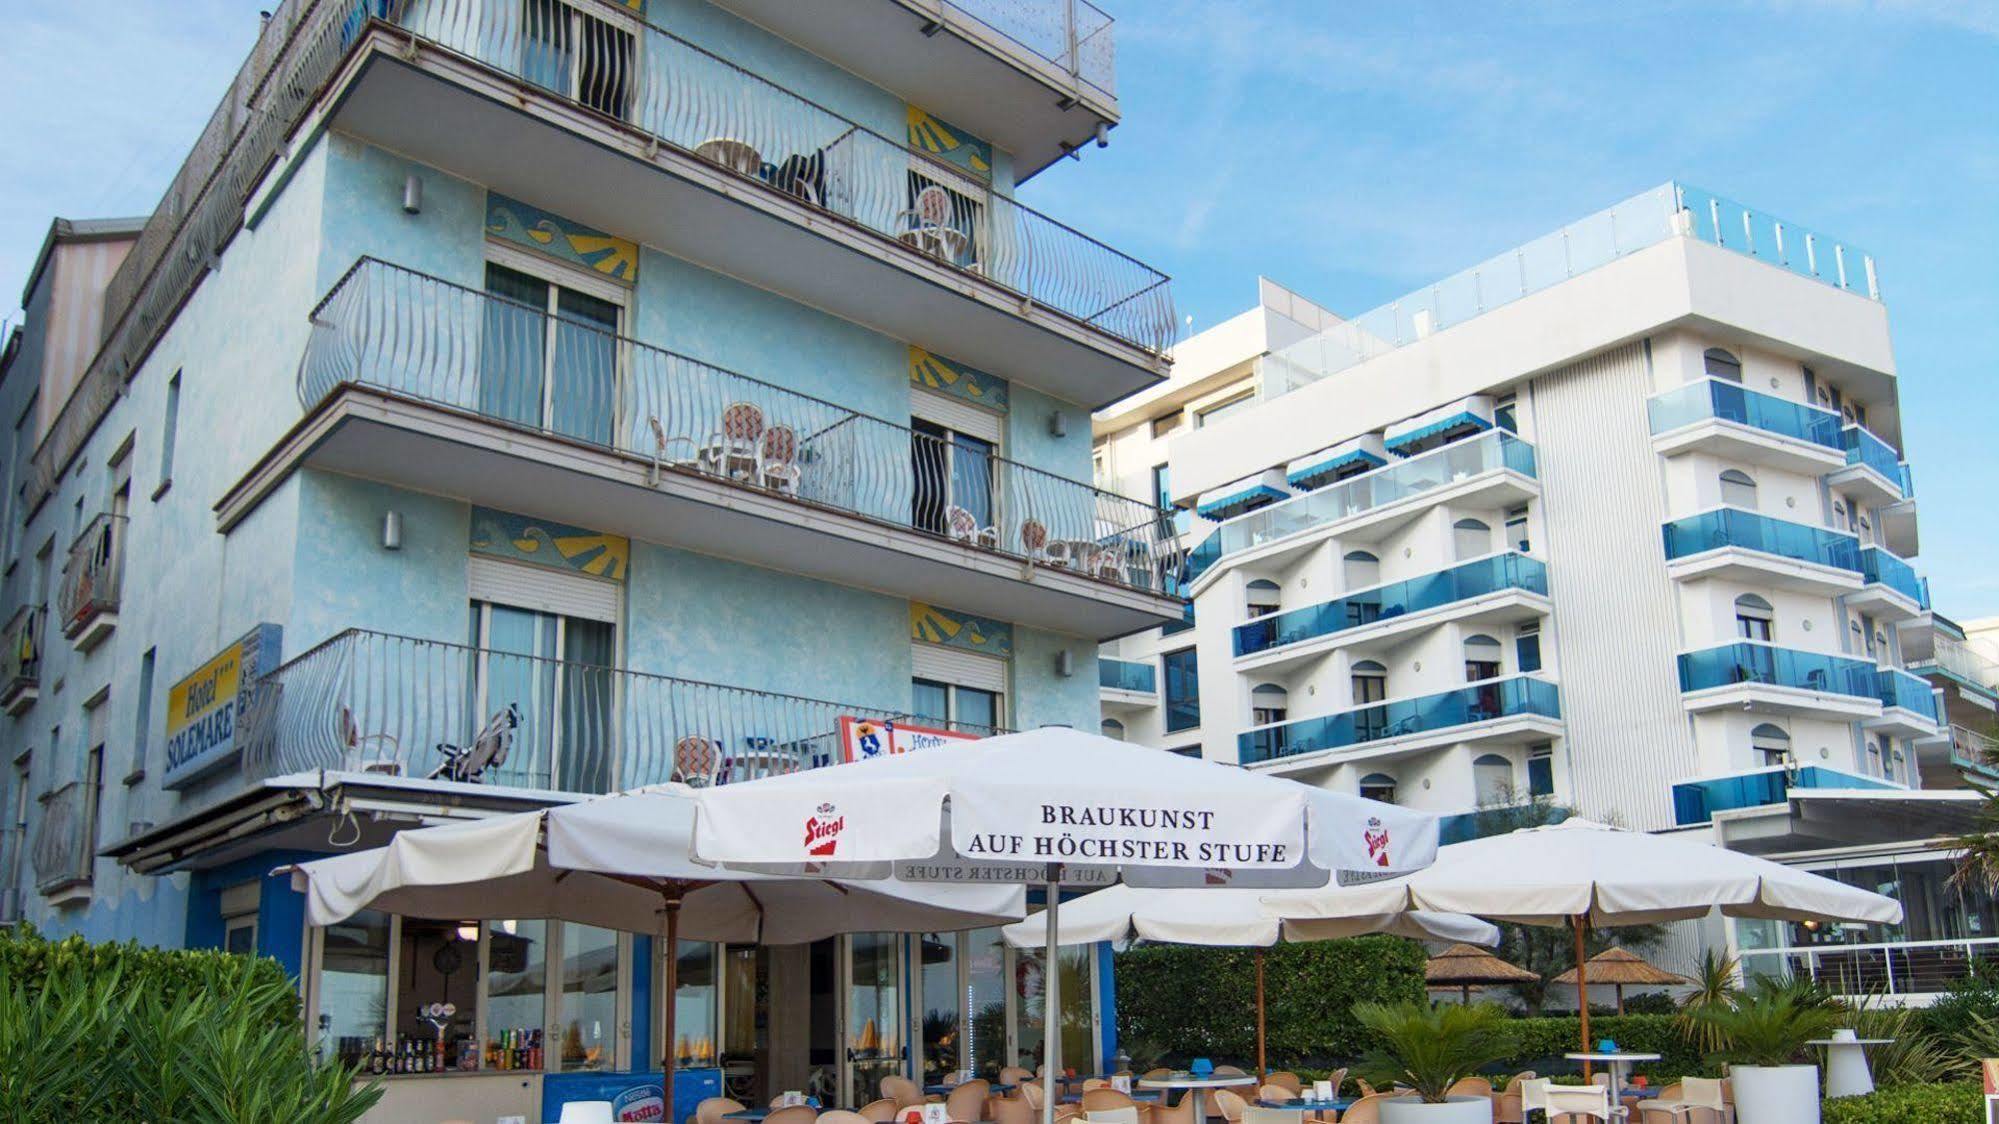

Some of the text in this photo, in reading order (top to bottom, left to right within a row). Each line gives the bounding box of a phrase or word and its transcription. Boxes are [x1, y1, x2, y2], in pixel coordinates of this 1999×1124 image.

[186, 669, 217, 718] Hotel
[166, 702, 233, 773] SOLEMARE
[804, 815, 844, 847] Stiegl
[1041, 805, 1214, 830] BRAUKUNST
[968, 832, 1287, 862] AUF HÖCHSTER STUFE
